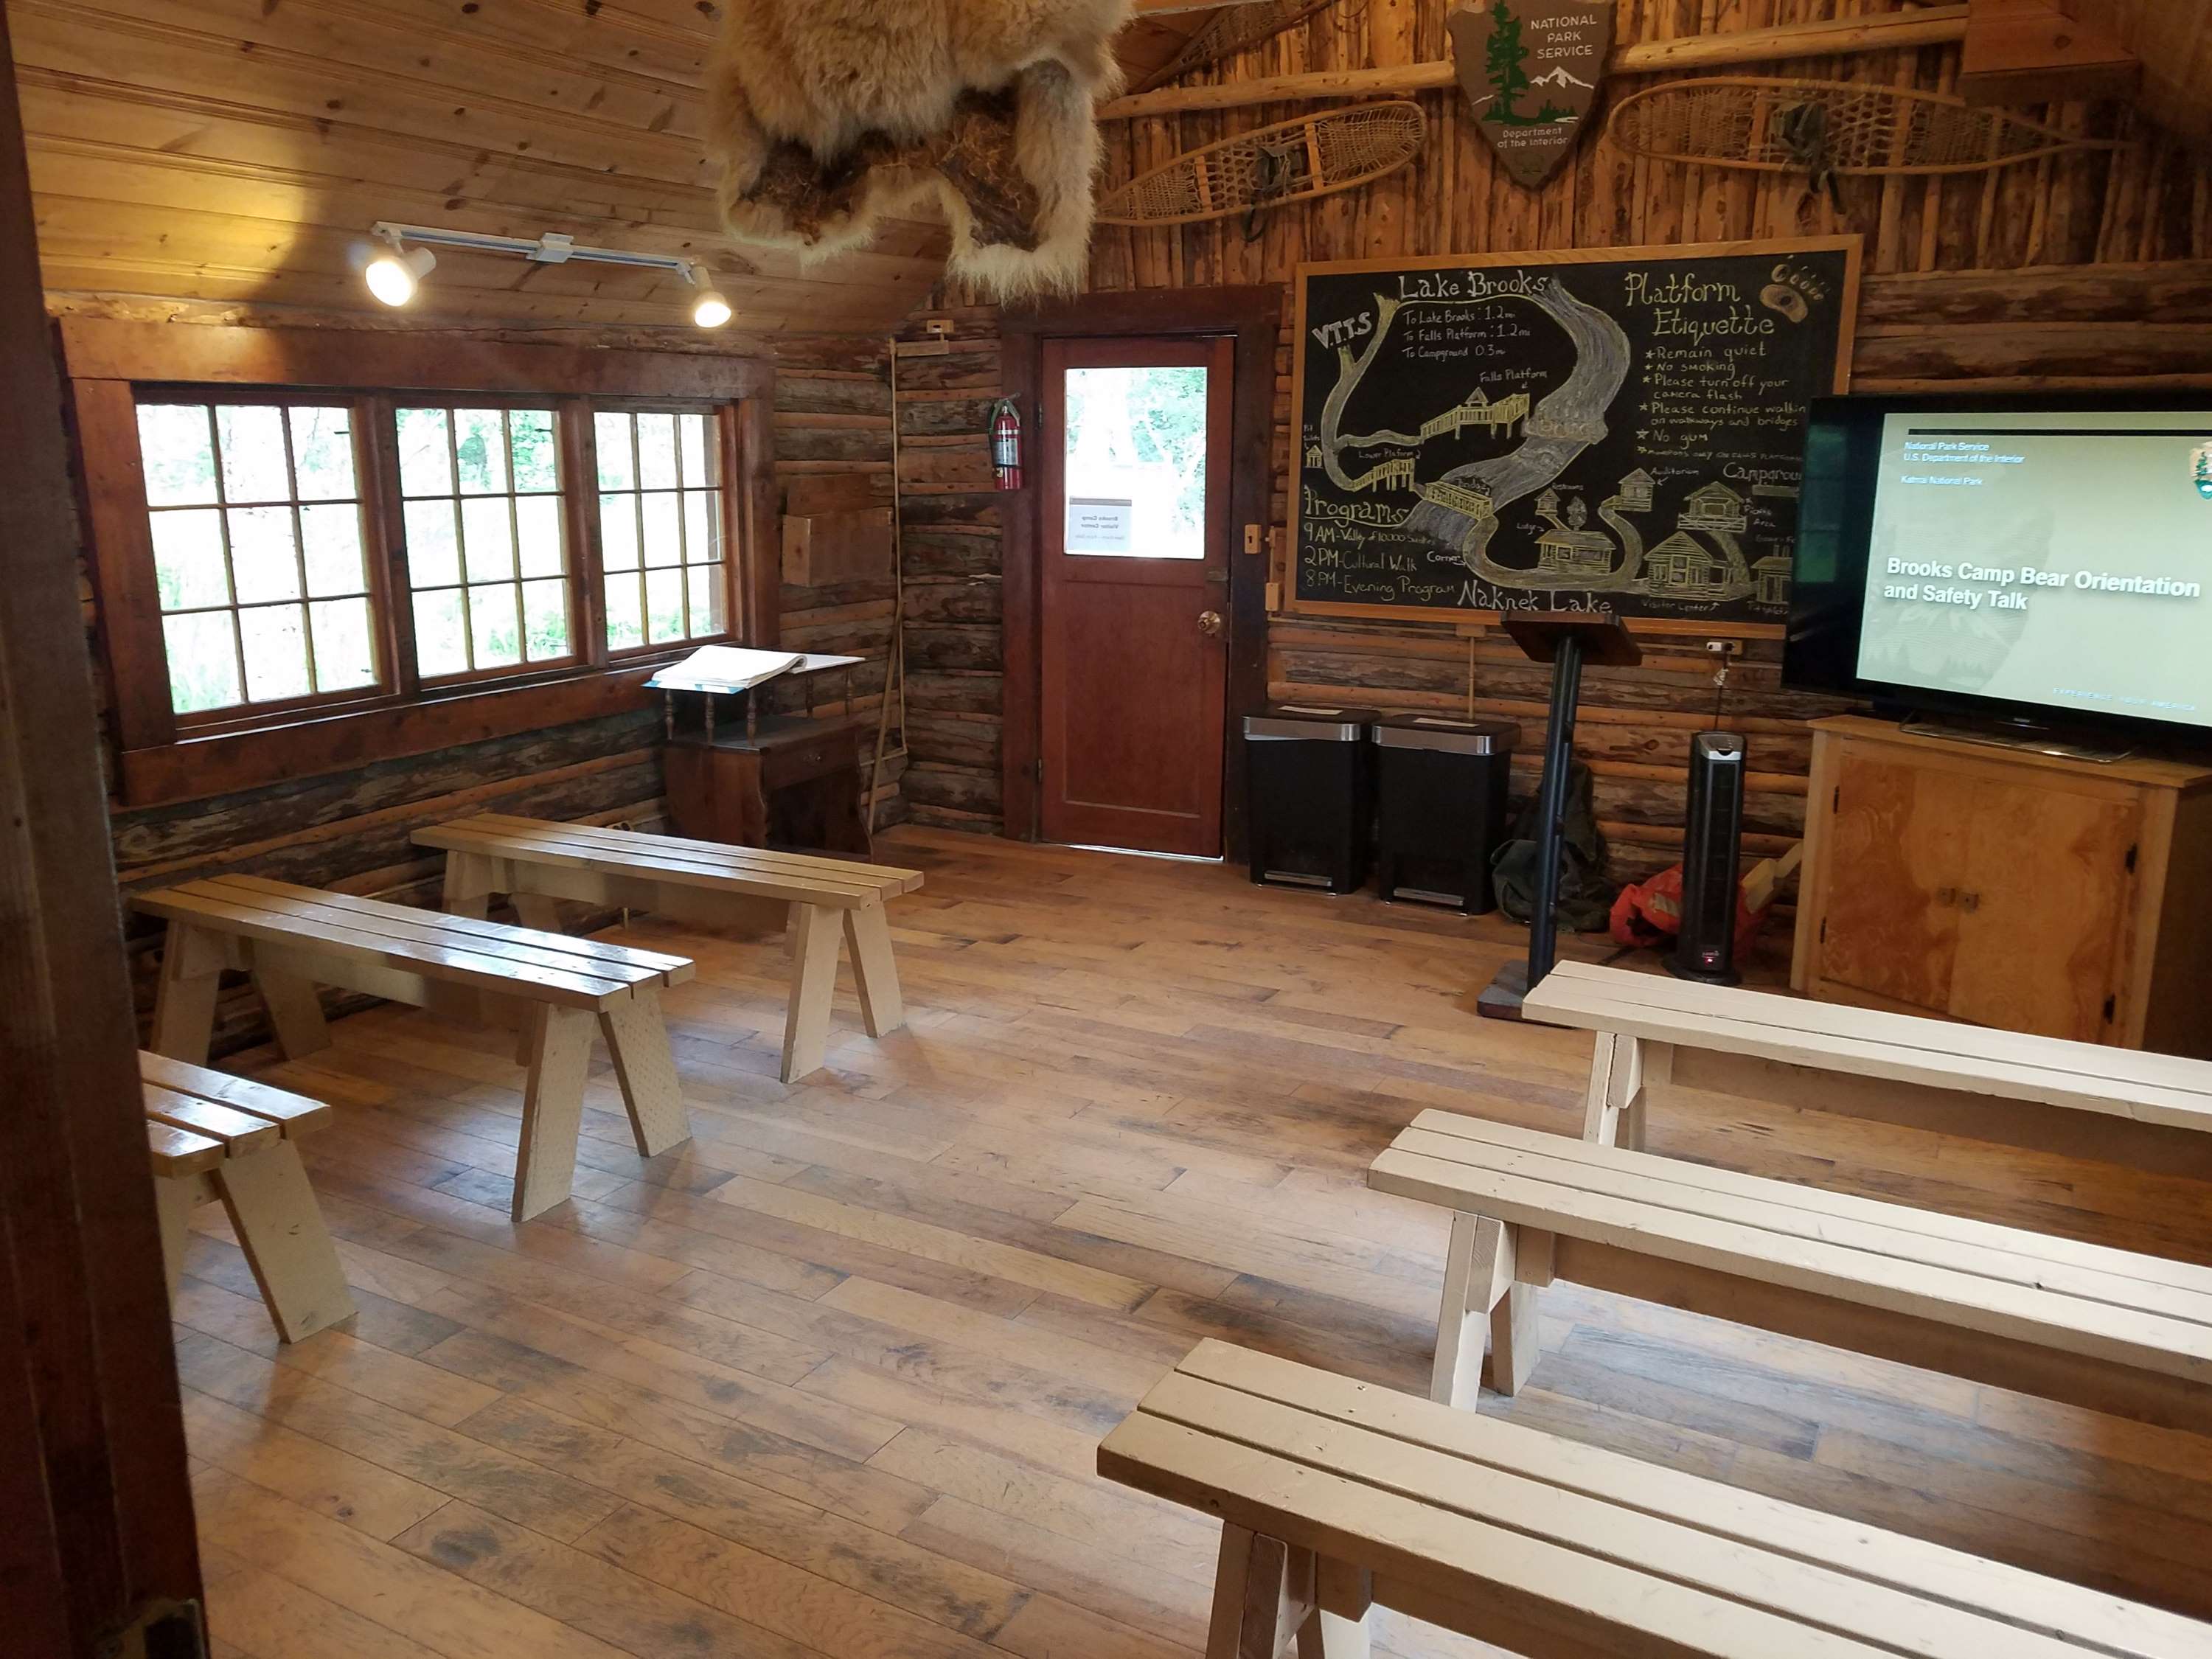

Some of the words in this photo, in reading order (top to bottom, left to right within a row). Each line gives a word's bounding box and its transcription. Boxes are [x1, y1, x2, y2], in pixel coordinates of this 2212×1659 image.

[1531, 14, 1597, 29] NATIONAL
[1548, 31, 1582, 43] PARK
[1537, 45, 1593, 59] SERVICE
[1503, 127, 1562, 139] Department
[1498, 140, 1507, 148] of
[1511, 139, 1526, 147] the
[1530, 137, 1568, 146] Interior
[1398, 273, 1460, 299] Lake
[1468, 269, 1549, 297] Brooks
[1624, 271, 1741, 307] Platform
[1402, 310, 1416, 325] To
[1419, 311, 1443, 323] Lake
[1652, 305, 1775, 347] Etiquette
[1403, 331, 1413, 341] To
[1419, 329, 1441, 341] Falls
[1402, 347, 1415, 358] To
[1418, 345, 1468, 362] Campground
[1657, 347, 1712, 359] Remain
[1724, 341, 1767, 363] quiet
[1480, 371, 1502, 383] Falls
[1505, 367, 1547, 380] Platform
[1656, 363, 1673, 372] No
[1655, 375, 1694, 387] Please
[1700, 378, 1728, 388] turn
[1733, 375, 1755, 388] off
[1759, 379, 1790, 396] your
[1654, 391, 1700, 400] camera
[1707, 389, 1742, 400] flash
[1652, 402, 1694, 414] Please
[1702, 405, 1759, 414] continue
[1651, 417, 1665, 425] on
[1669, 417, 1723, 430] walkways
[1730, 416, 1749, 426] and
[1757, 415, 1798, 431] bridges
[1652, 429, 1670, 442] No
[1905, 442, 1936, 450] National
[1938, 442, 1957, 451] Park
[1958, 443, 1989, 451] Service
[1922, 453, 1968, 462] Department
[1969, 454, 1978, 462] of
[1980, 454, 1994, 462] the
[1963, 477, 1983, 485] Park
[1304, 484, 1409, 528] Programs
[1427, 551, 1461, 563] Corner
[1887, 557, 1952, 580] Brooks
[1958, 563, 2014, 585] Camp
[2020, 568, 2069, 588] Bear
[2074, 571, 2200, 599] Orientation
[1344, 574, 1394, 601] Evening
[1397, 575, 1455, 602] Program
[1458, 580, 1539, 611] Naknek
[1549, 591, 1612, 613] Lake
[1884, 582, 1918, 600] and
[1922, 585, 1983, 610] Safety
[1987, 591, 2028, 610] Talk
